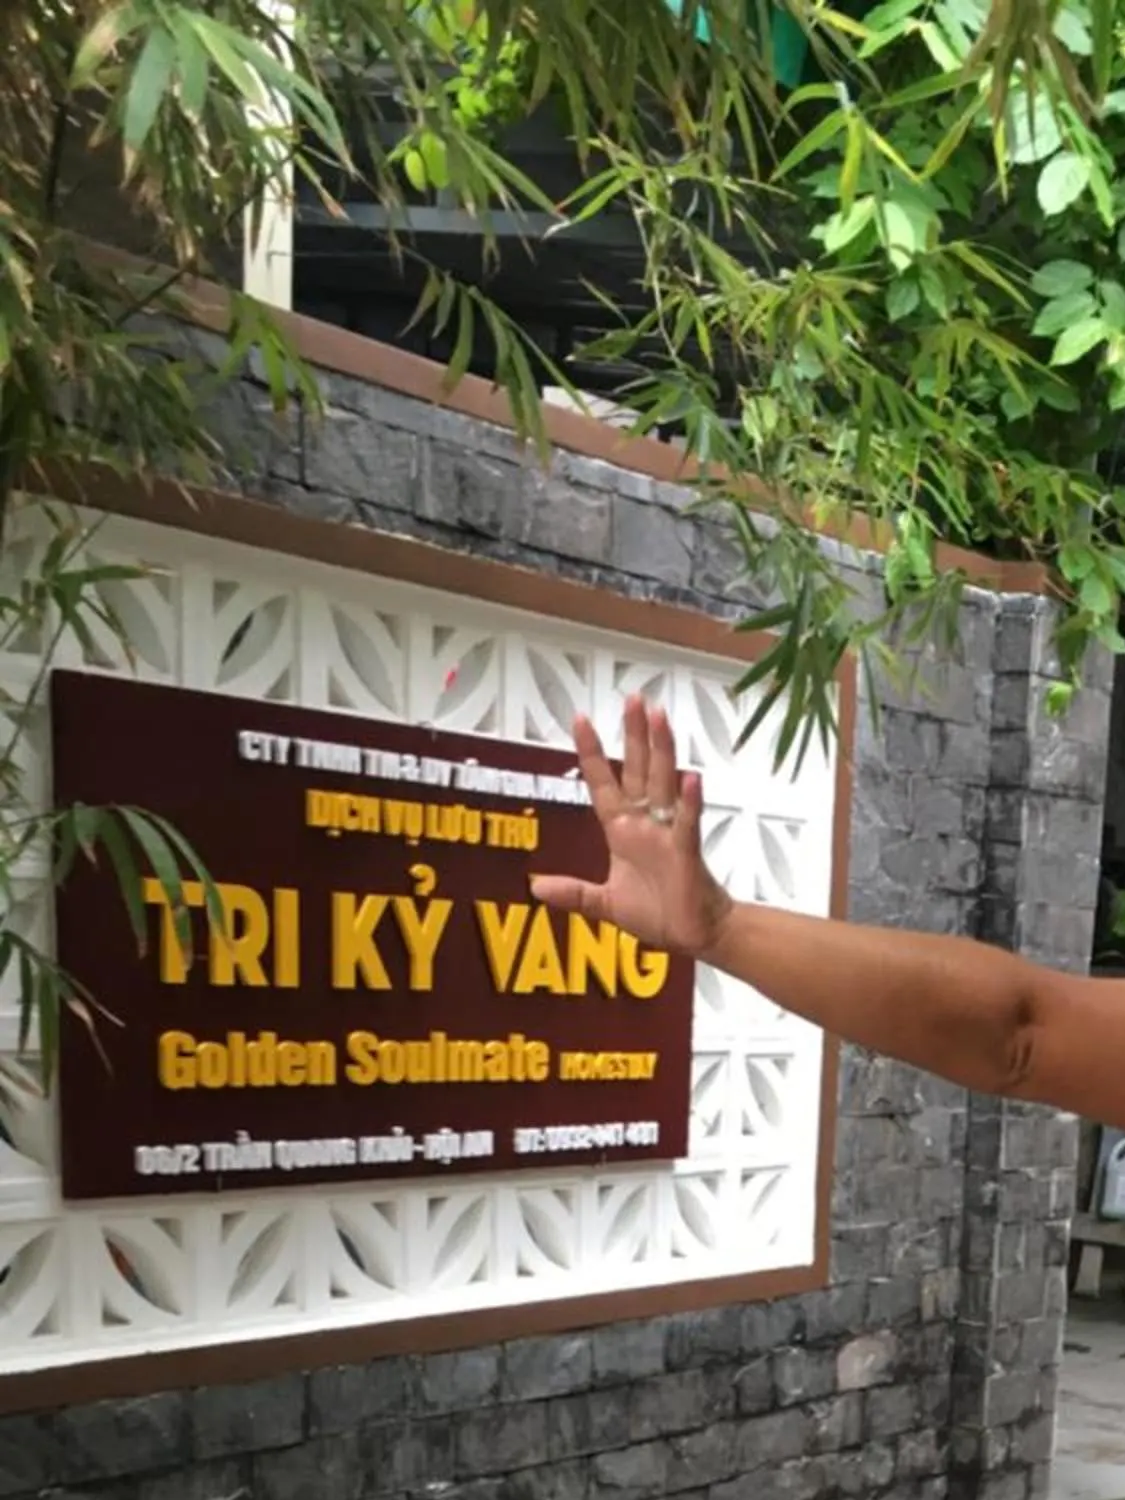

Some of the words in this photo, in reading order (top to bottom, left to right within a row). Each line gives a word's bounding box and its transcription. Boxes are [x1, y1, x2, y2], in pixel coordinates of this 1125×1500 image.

[237, 730, 290, 766] CTY
[306, 787, 381, 838] DỊCH
[383, 798, 424, 847] VỤ
[424, 803, 482, 845] LƯU
[485, 806, 540, 851] TRÚ
[143, 876, 300, 988] TRI
[331, 862, 454, 991] KỶ
[158, 1030, 337, 1090] Golden
[345, 1029, 549, 1086] Soulmate
[558, 1051, 658, 1081] HOMESTAY
[201, 1129, 273, 1172] TRẦN
[273, 1138, 357, 1171] QUANG
